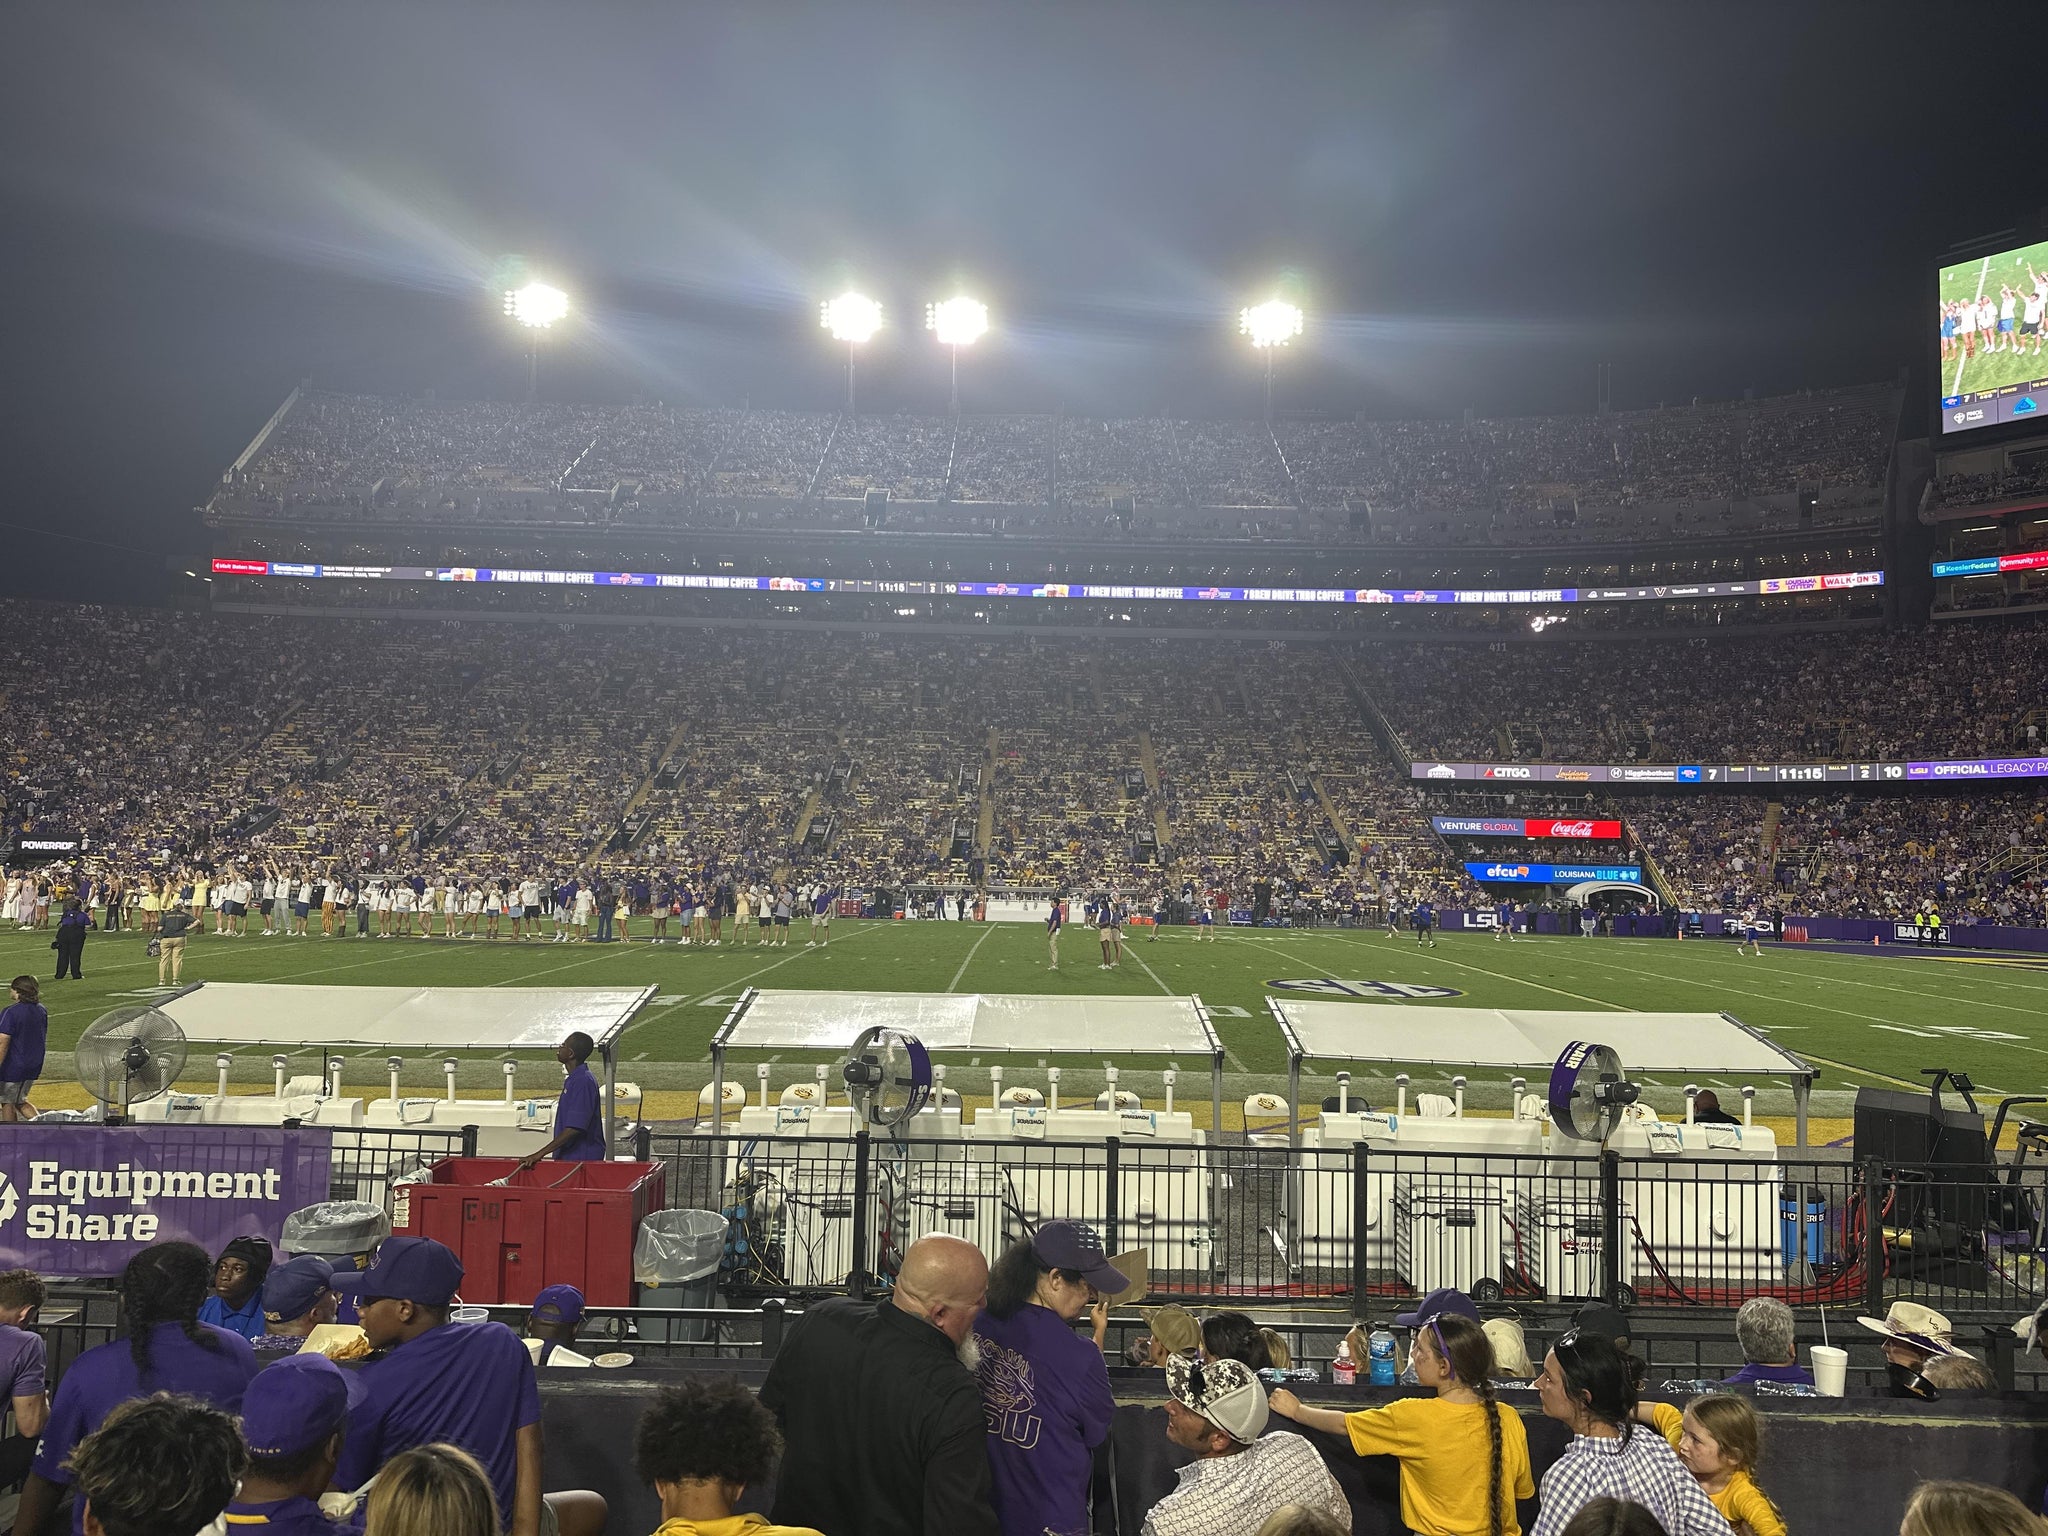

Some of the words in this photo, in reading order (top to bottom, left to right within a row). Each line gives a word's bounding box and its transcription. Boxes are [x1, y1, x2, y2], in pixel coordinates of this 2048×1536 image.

[497, 571, 519, 582] BREW
[520, 571, 544, 582] DRIVE
[544, 572, 565, 583] THRU
[566, 572, 594, 584] COFFEE
[662, 576, 684, 587] BREW
[685, 576, 708, 587] DRIVE
[709, 577, 730, 588] THRU
[731, 577, 758, 588] COFFEE
[1826, 574, 1878, 587] WALK-ON'S
[829, 581, 835, 590] 7
[945, 584, 957, 593] 10
[1089, 586, 1111, 597] BREW
[1111, 587, 1134, 598] DRIVE
[1135, 587, 1155, 598] THRU
[1156, 588, 1183, 599] COFFEE
[1250, 589, 1271, 600] BREW
[1272, 590, 1295, 601] DRIVE
[1296, 590, 1316, 601] THRU
[1317, 590, 1345, 601] COFFEE
[1461, 592, 1483, 602] BREW
[1484, 591, 1508, 602] DRIVE
[1509, 591, 1531, 602] THRU
[1531, 590, 1562, 602] COFFEE
[1493, 767, 1531, 778] CITGO
[1624, 769, 1675, 778] Higginbotham
[1708, 769, 1717, 780] 7
[1779, 768, 1823, 780] 11:15
[1861, 770, 1869, 778] 2
[1884, 766, 1902, 778] 10
[1934, 764, 1988, 775] OFFICIAL
[1990, 762, 2035, 774] LEGACY
[1440, 822, 1482, 831] VENTURE
[1482, 822, 1518, 831] GLOBAL
[1487, 864, 1518, 878] efcu
[1554, 870, 1596, 879] LOUISIANA
[1596, 870, 1619, 880] BLUE
[1723, 919, 1786, 933] GECO
[1360, 1116, 1388, 1124] POWERAD
[28, 1161, 281, 1205] Equipment
[26, 1204, 160, 1242] Share
[982, 1402, 1042, 1450] SU
